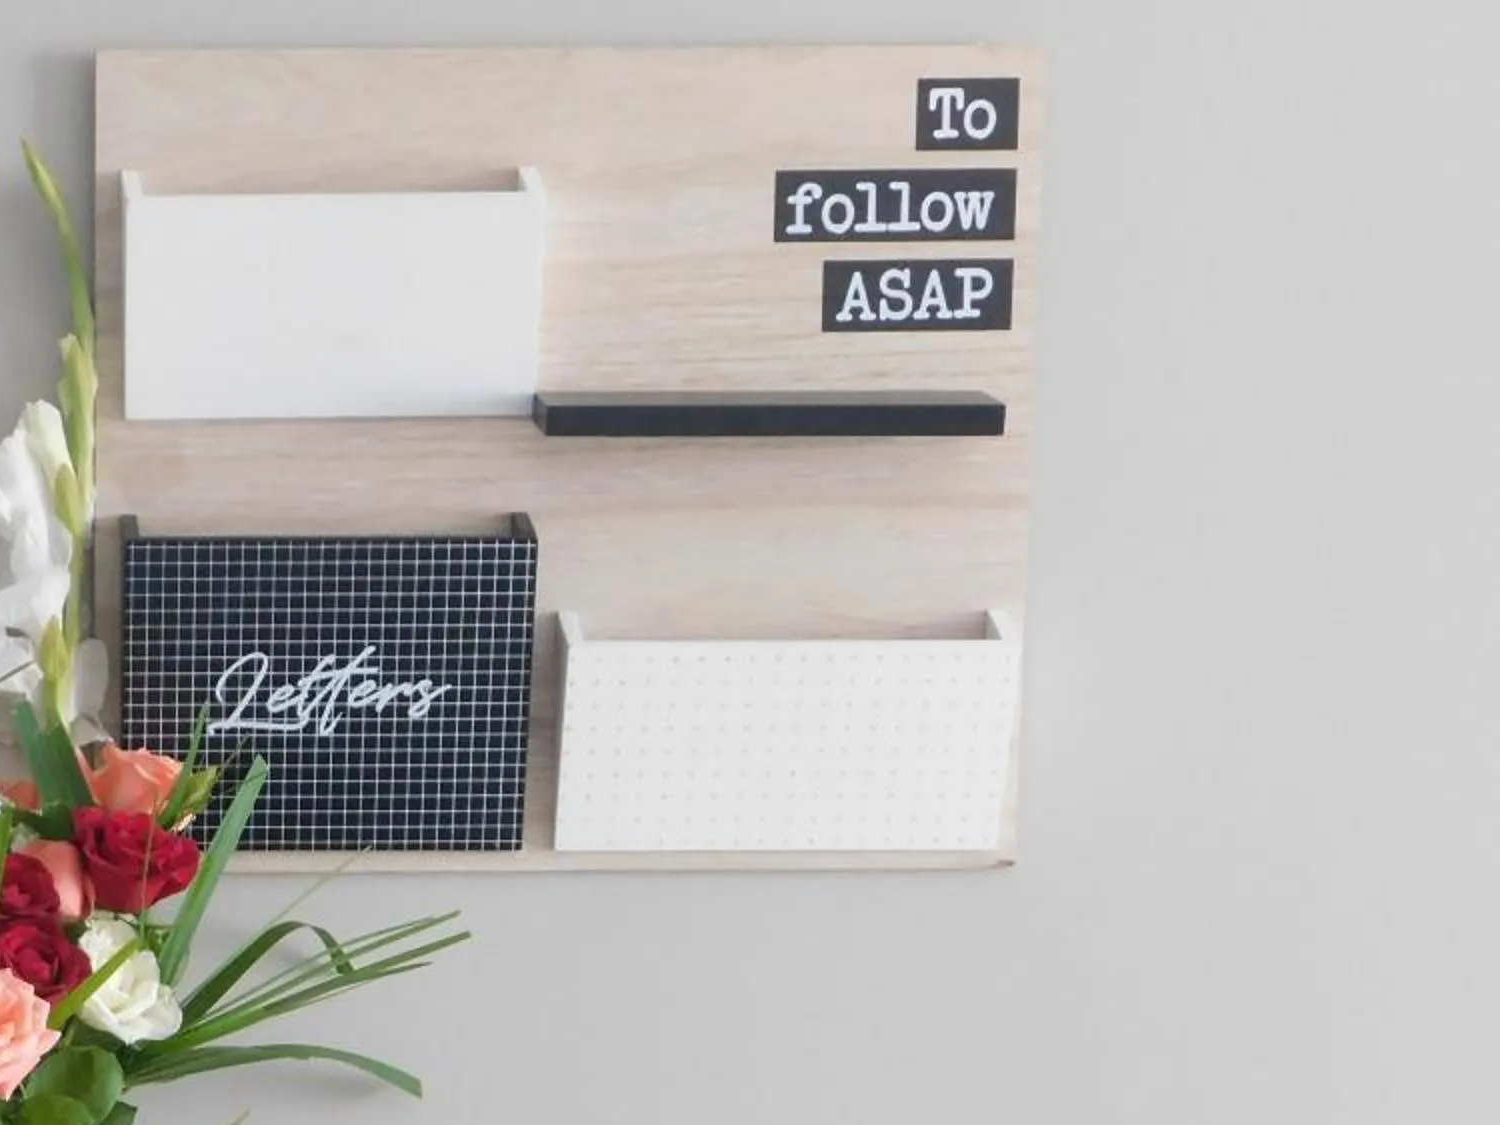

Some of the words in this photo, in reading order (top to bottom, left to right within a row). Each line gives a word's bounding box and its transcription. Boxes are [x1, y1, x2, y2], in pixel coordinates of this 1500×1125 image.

[928, 87, 997, 140] To
[785, 181, 996, 235] follow
[836, 267, 994, 321] ASAP
[206, 644, 452, 737] Letters
